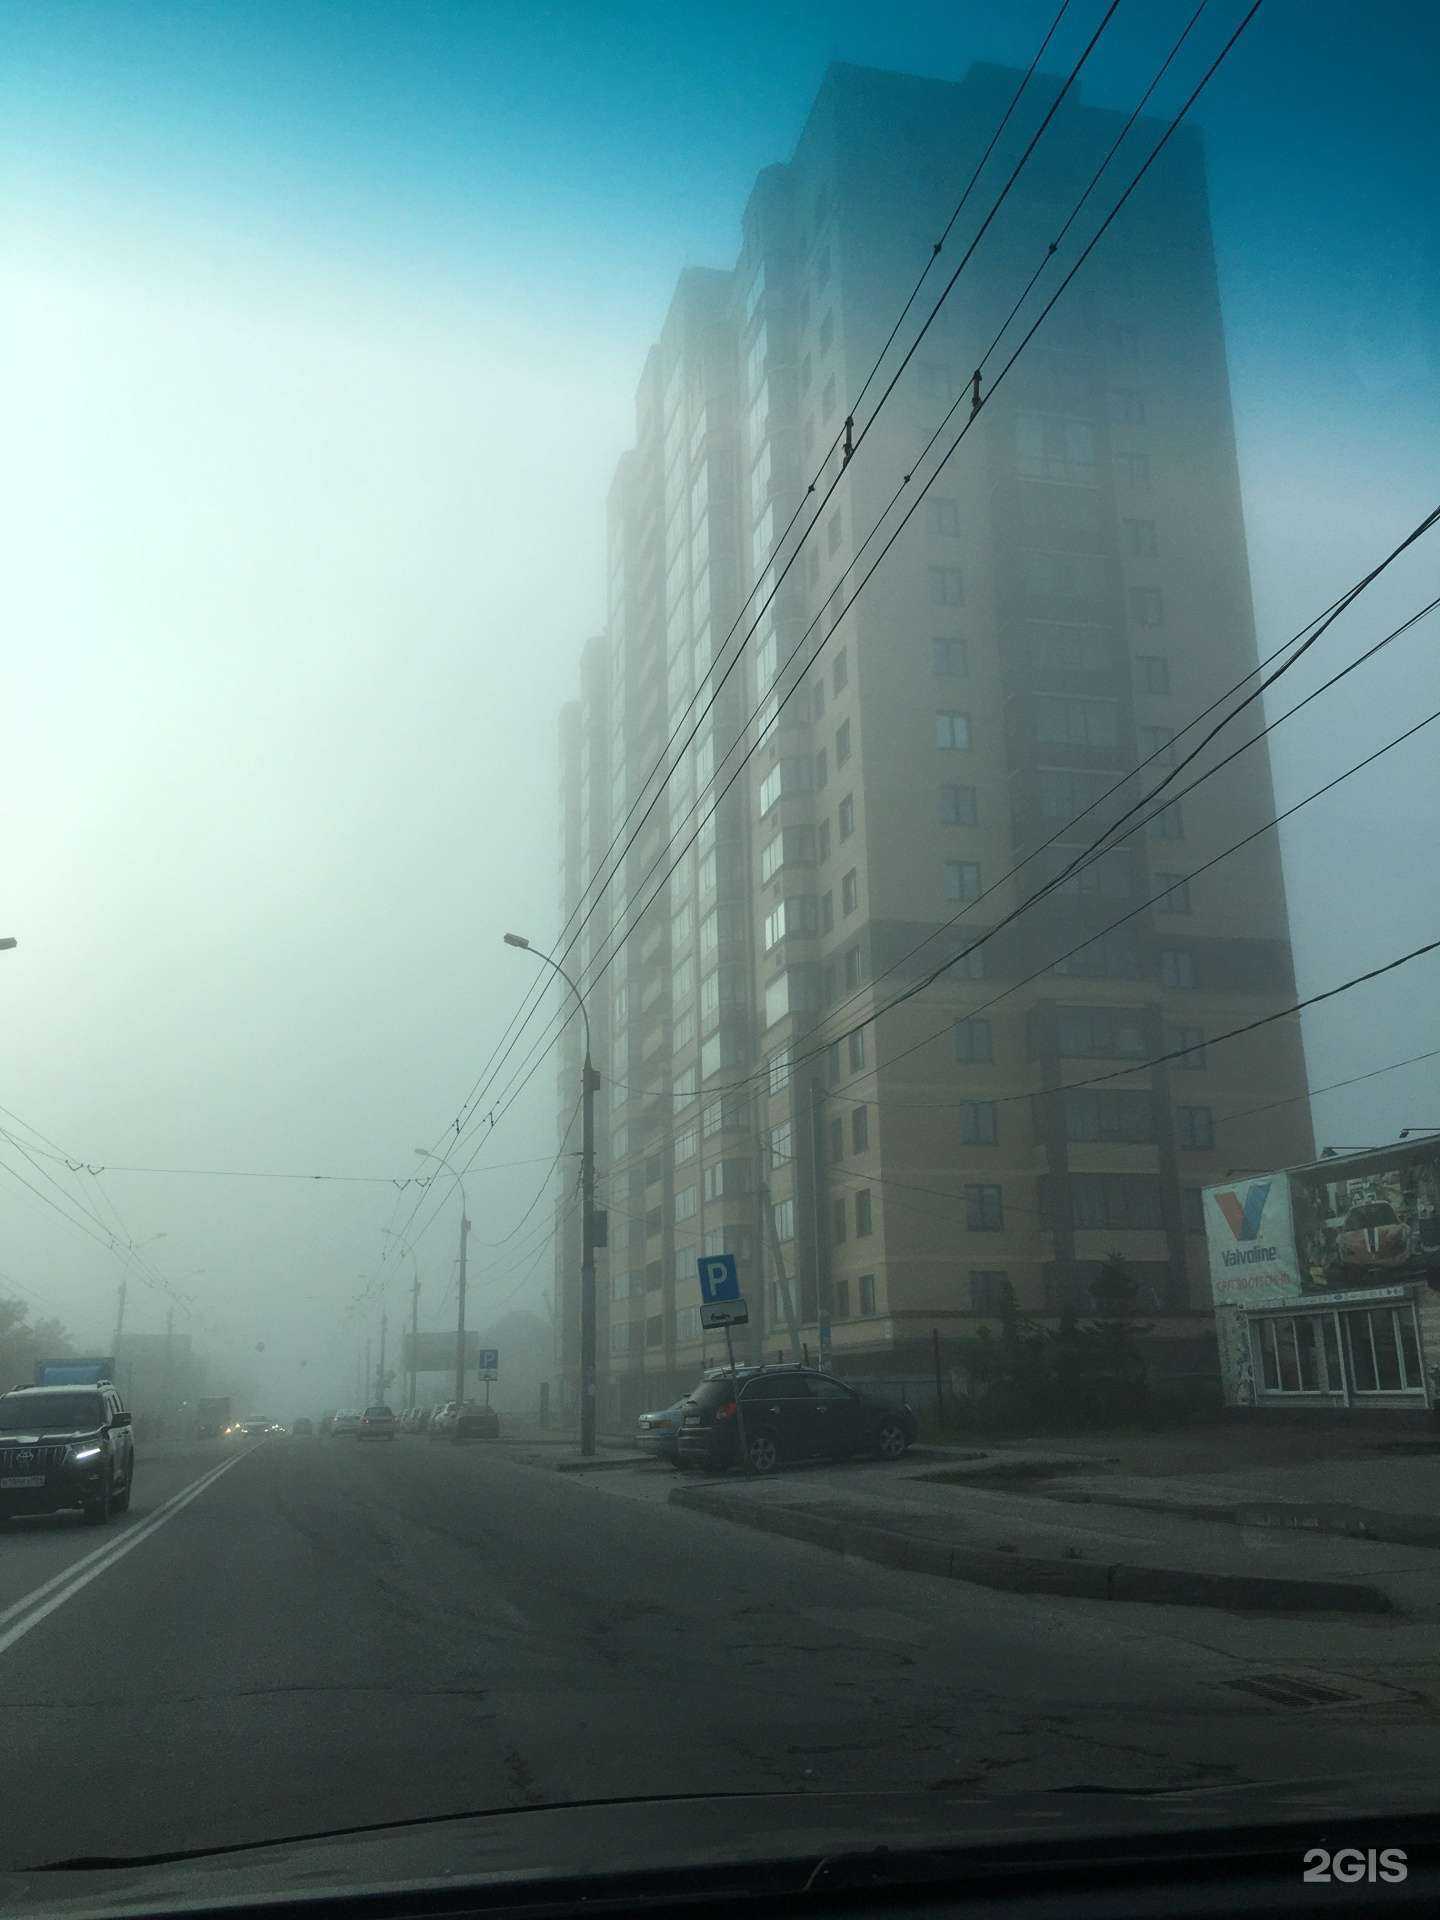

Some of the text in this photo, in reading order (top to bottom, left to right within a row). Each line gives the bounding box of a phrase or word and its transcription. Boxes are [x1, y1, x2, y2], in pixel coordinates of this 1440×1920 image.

[1223, 1247, 1277, 1267] Valvoline
[708, 1264, 728, 1296] P
[484, 1352, 496, 1368] P
